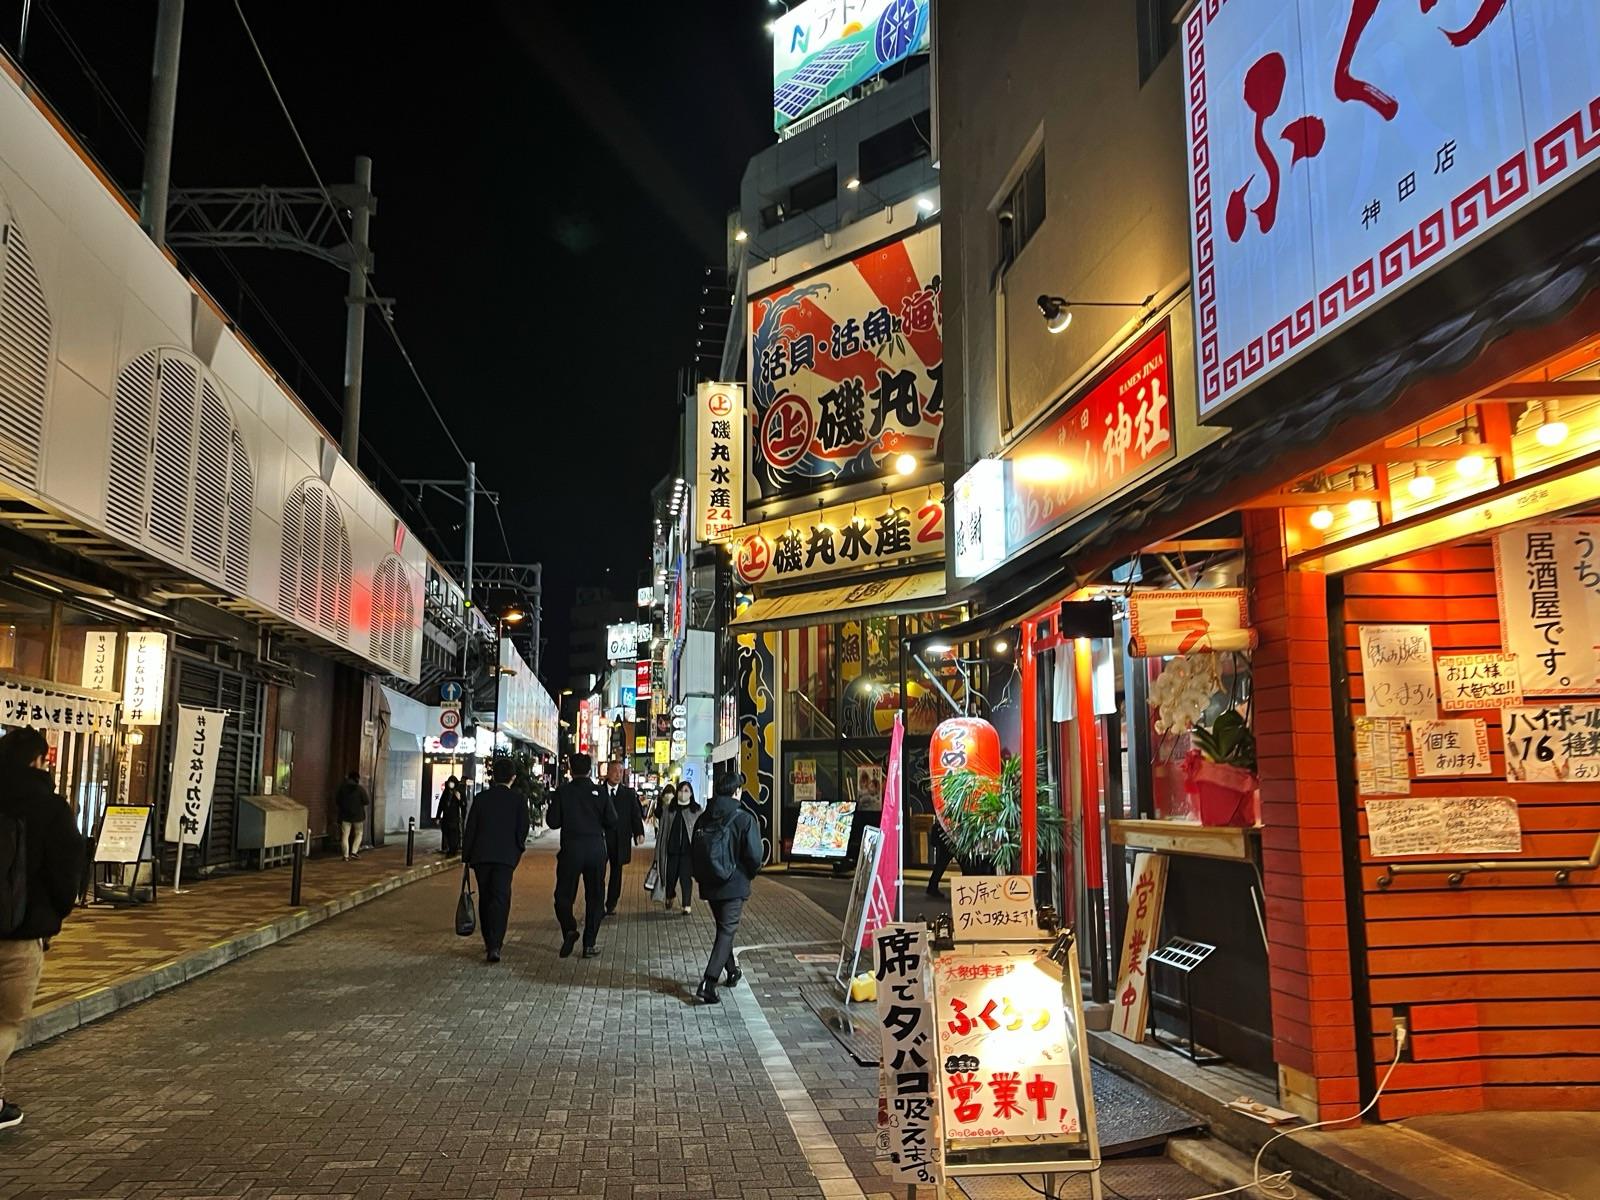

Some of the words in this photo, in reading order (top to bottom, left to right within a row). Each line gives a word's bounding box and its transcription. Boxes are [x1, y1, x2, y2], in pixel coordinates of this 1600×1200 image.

[1361, 138, 1458, 231] 神田店
[901, 287, 943, 336] 海
[1142, 353, 1164, 380] JINJA
[710, 420, 731, 508] 磯丸水産
[706, 508, 733, 521] 24
[771, 506, 911, 575] 磯丸水産
[1525, 531, 1571, 687] 居酒屋です。
[1446, 662, 1503, 681] お1人様
[444, 714, 456, 725] 30
[1424, 730, 1461, 752] 個室
[1436, 752, 1483, 769] あります。
[956, 880, 1003, 906] お席で
[1121, 869, 1155, 1034] 営業中
[875, 927, 936, 1184] 席でタバコ吸えます。
[947, 1070, 1069, 1125] 営業中!
